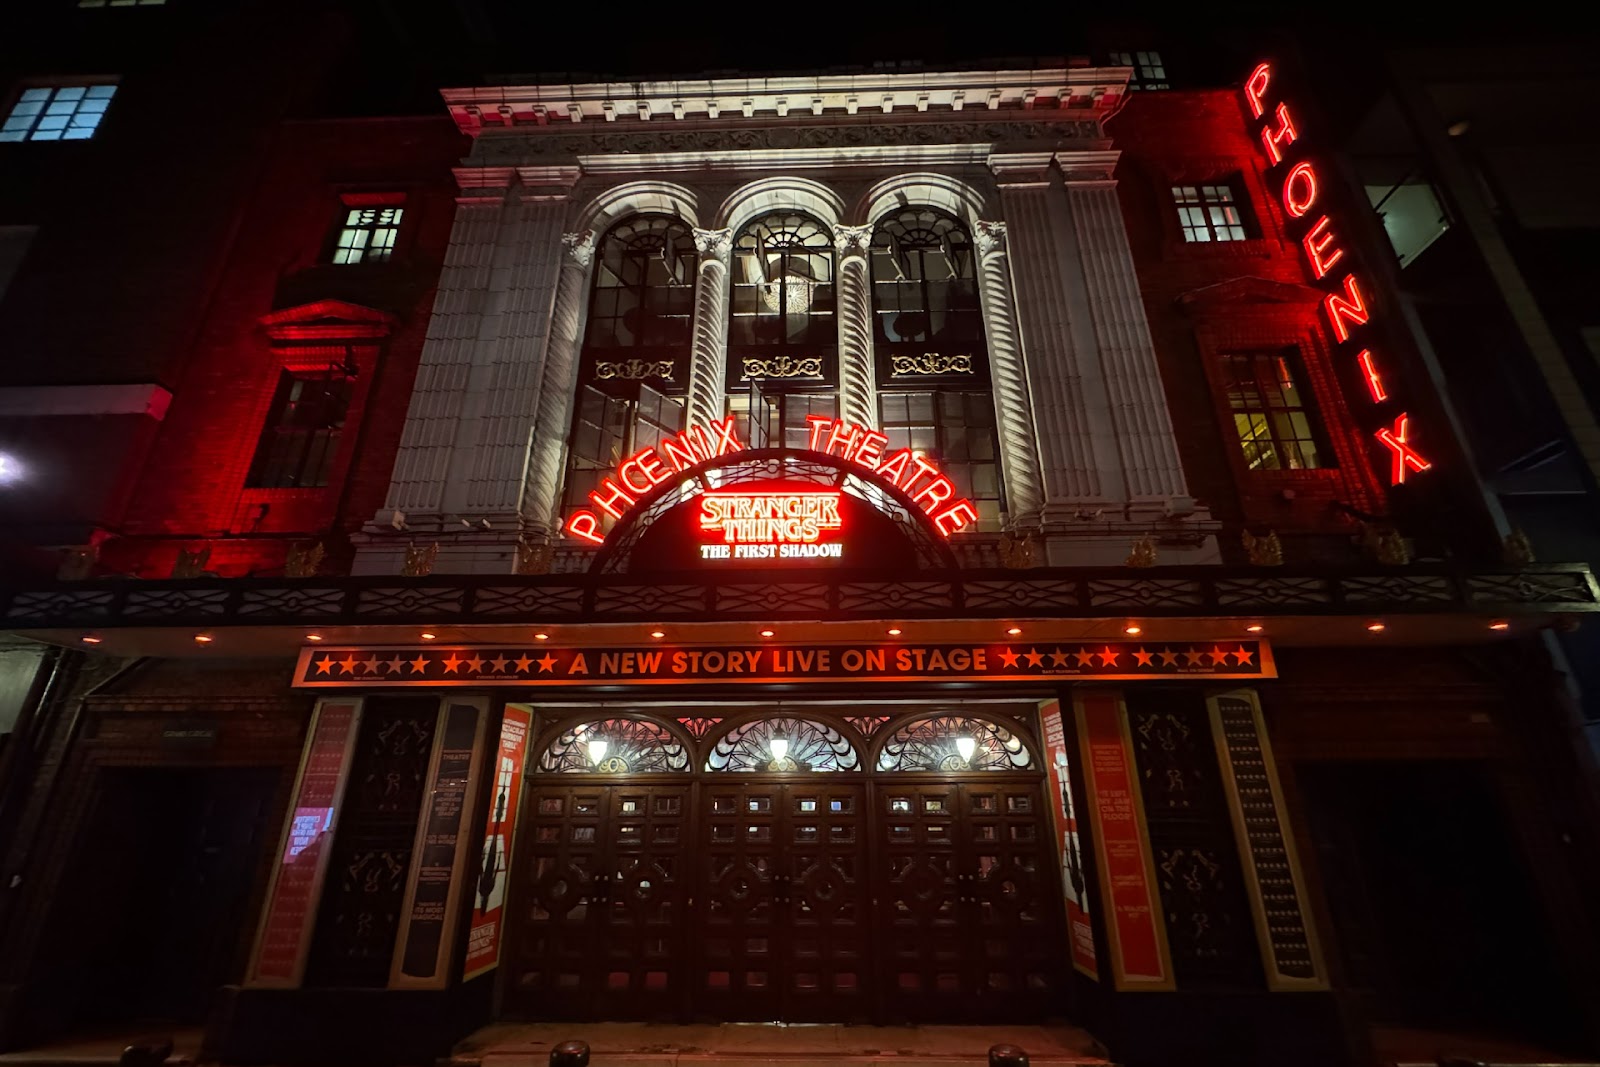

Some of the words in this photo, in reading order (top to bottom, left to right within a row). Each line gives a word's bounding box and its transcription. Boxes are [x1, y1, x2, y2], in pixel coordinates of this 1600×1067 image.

[1244, 63, 1431, 487] PHOENIX
[804, 415, 980, 538] THEATRE
[700, 496, 842, 523] STRANGER
[722, 518, 820, 543] THINGS
[700, 544, 731, 559] THE
[734, 544, 777, 558] FIRST
[779, 543, 843, 558] SHADOW
[568, 652, 589, 675] A
[600, 652, 663, 674] NEW
[672, 651, 762, 674] STORY
[772, 650, 831, 673] LIVE
[841, 649, 886, 672] ON
[895, 648, 988, 672] STAGE
